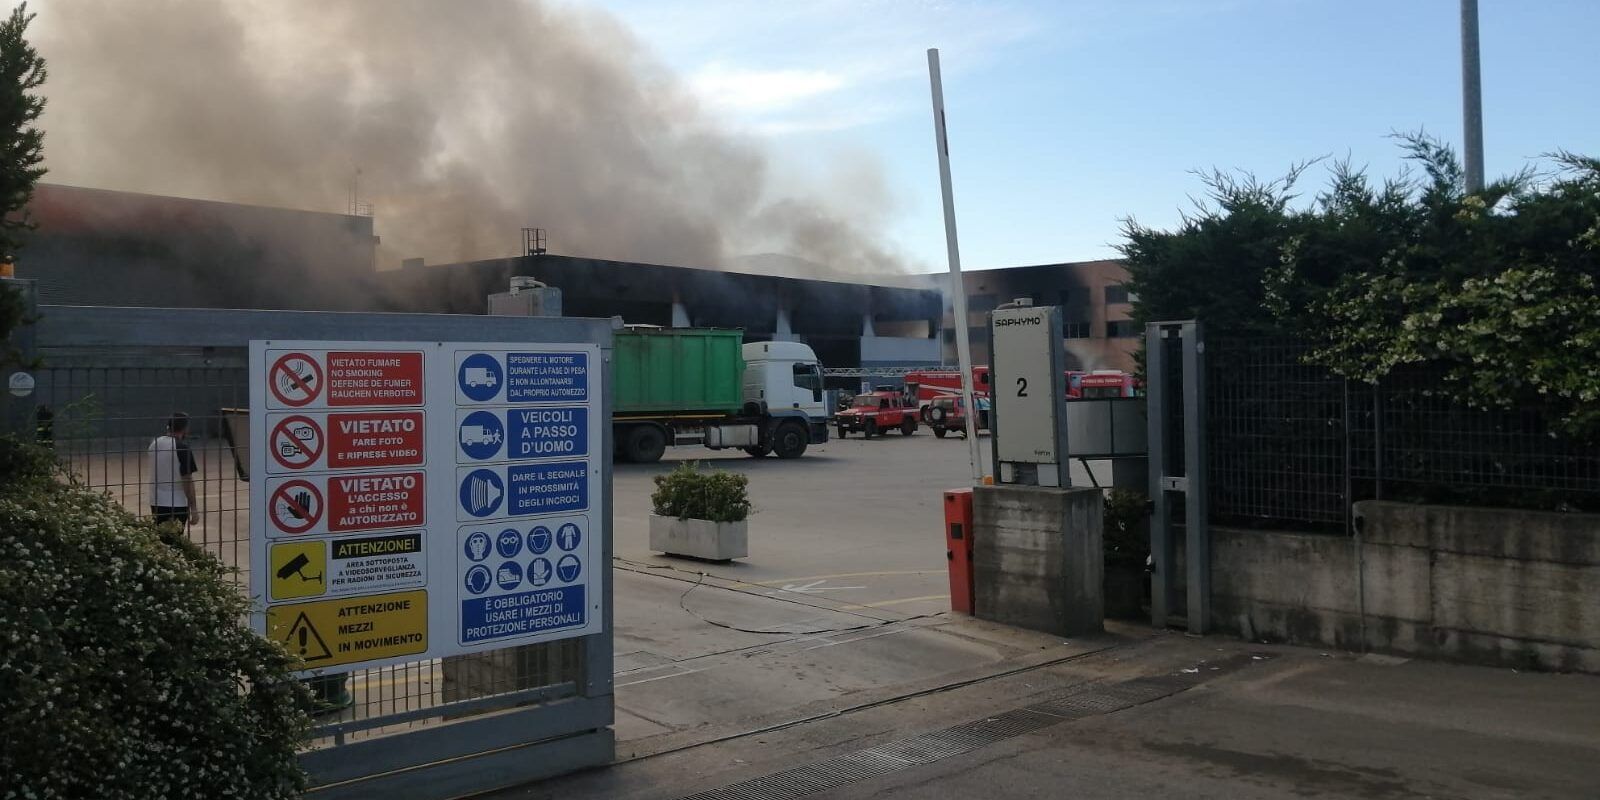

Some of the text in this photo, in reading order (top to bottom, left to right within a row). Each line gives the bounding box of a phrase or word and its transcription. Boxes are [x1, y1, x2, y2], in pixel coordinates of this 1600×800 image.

[995, 317, 1040, 327] SAPHYMO
[1016, 378, 1027, 397] 2
[521, 411, 572, 423] VEICOLI
[340, 419, 415, 434] VIETATO
[522, 426, 577, 438] A PASSO
[522, 440, 574, 453] D'UOMO
[346, 451, 387, 459] RIPRESE
[512, 473, 535, 482] DARE
[548, 469, 585, 480] SEGNALE
[340, 476, 416, 493] VIETATO
[348, 492, 408, 503] L'ACCESSO
[519, 495, 579, 508] DEGLI INCROCI
[359, 505, 375, 514] chi
[401, 503, 407, 511] è
[340, 513, 416, 526] AUTORIZZATO
[339, 538, 415, 556] ATTENZIONE!
[366, 557, 408, 566] SOTTOPOSTA
[346, 564, 415, 576] VIDEOSORVEGLIANZA
[386, 571, 422, 579] SICUREZZA
[486, 590, 563, 610] È OBBLIGATORIO
[338, 600, 411, 617] ATTENZIONE
[486, 604, 563, 622] USARE I MEZZI DI
[339, 622, 373, 635] MEZZI
[467, 612, 580, 639] PROTEZIONE PERSONALI
[339, 632, 422, 652] IN MOVIMENTO
